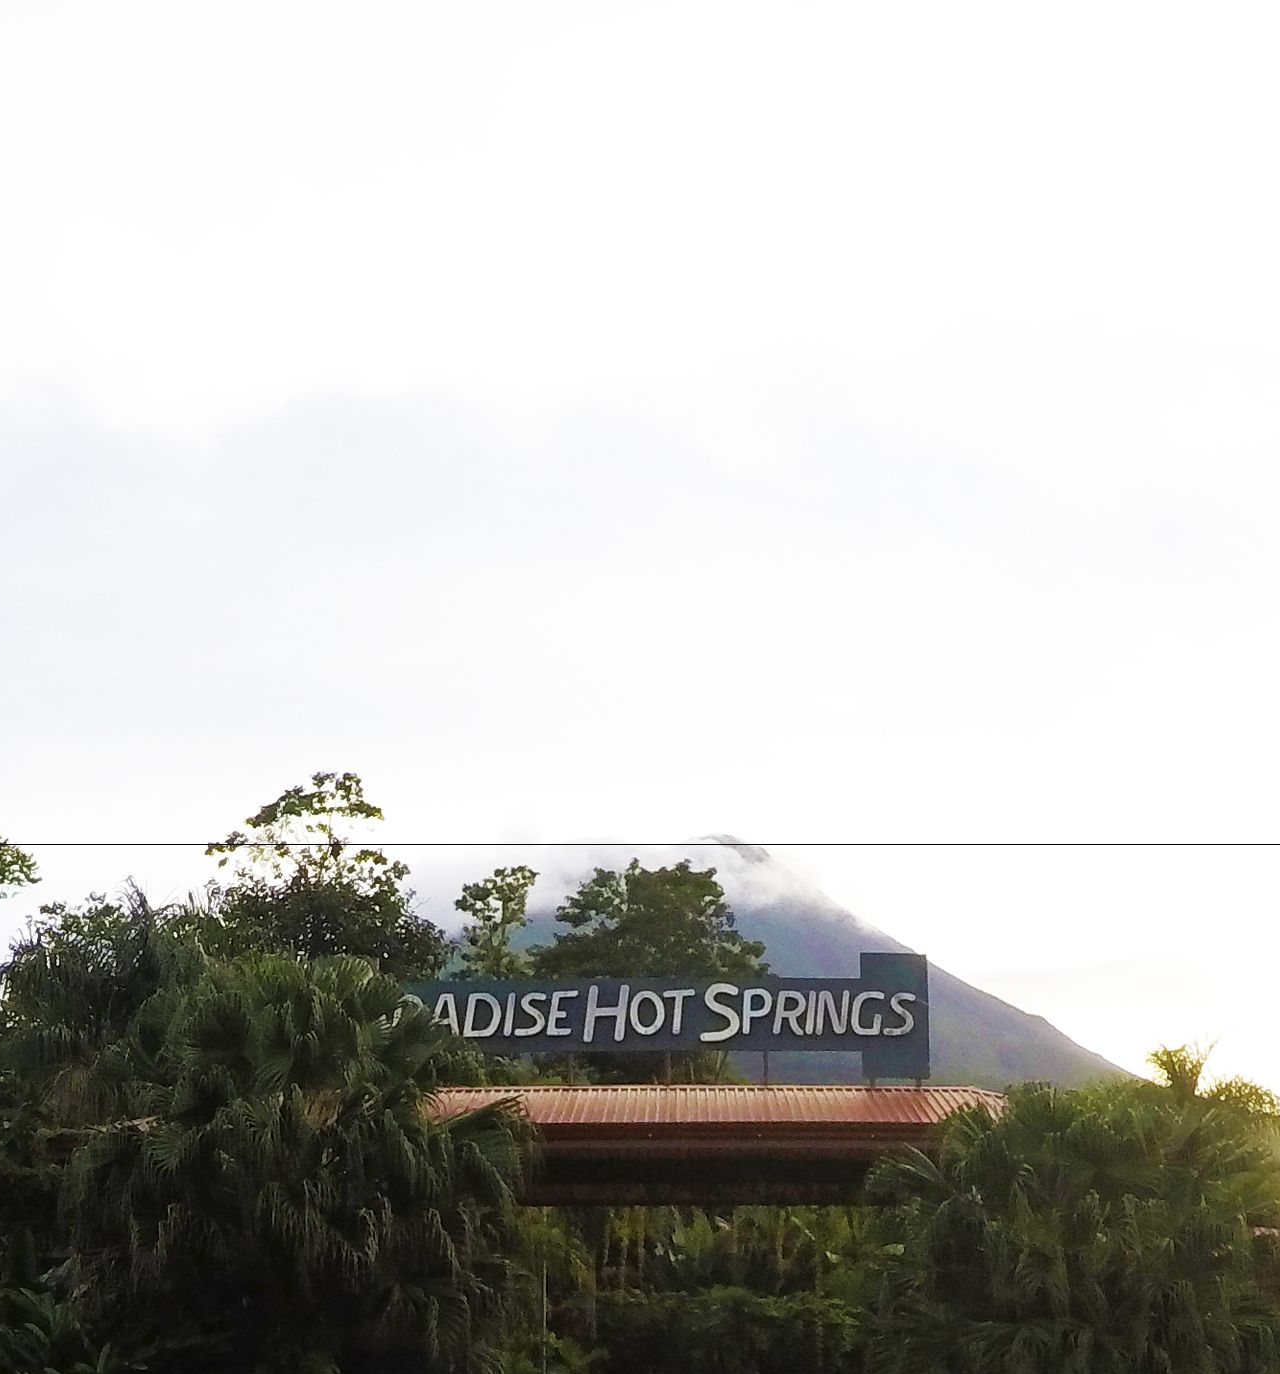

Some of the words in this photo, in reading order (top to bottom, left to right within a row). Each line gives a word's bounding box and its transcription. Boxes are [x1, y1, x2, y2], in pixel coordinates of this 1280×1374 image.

[396, 989, 579, 1038] ADISE
[582, 984, 695, 1043] HOT
[699, 982, 917, 1043] SPRINGS
